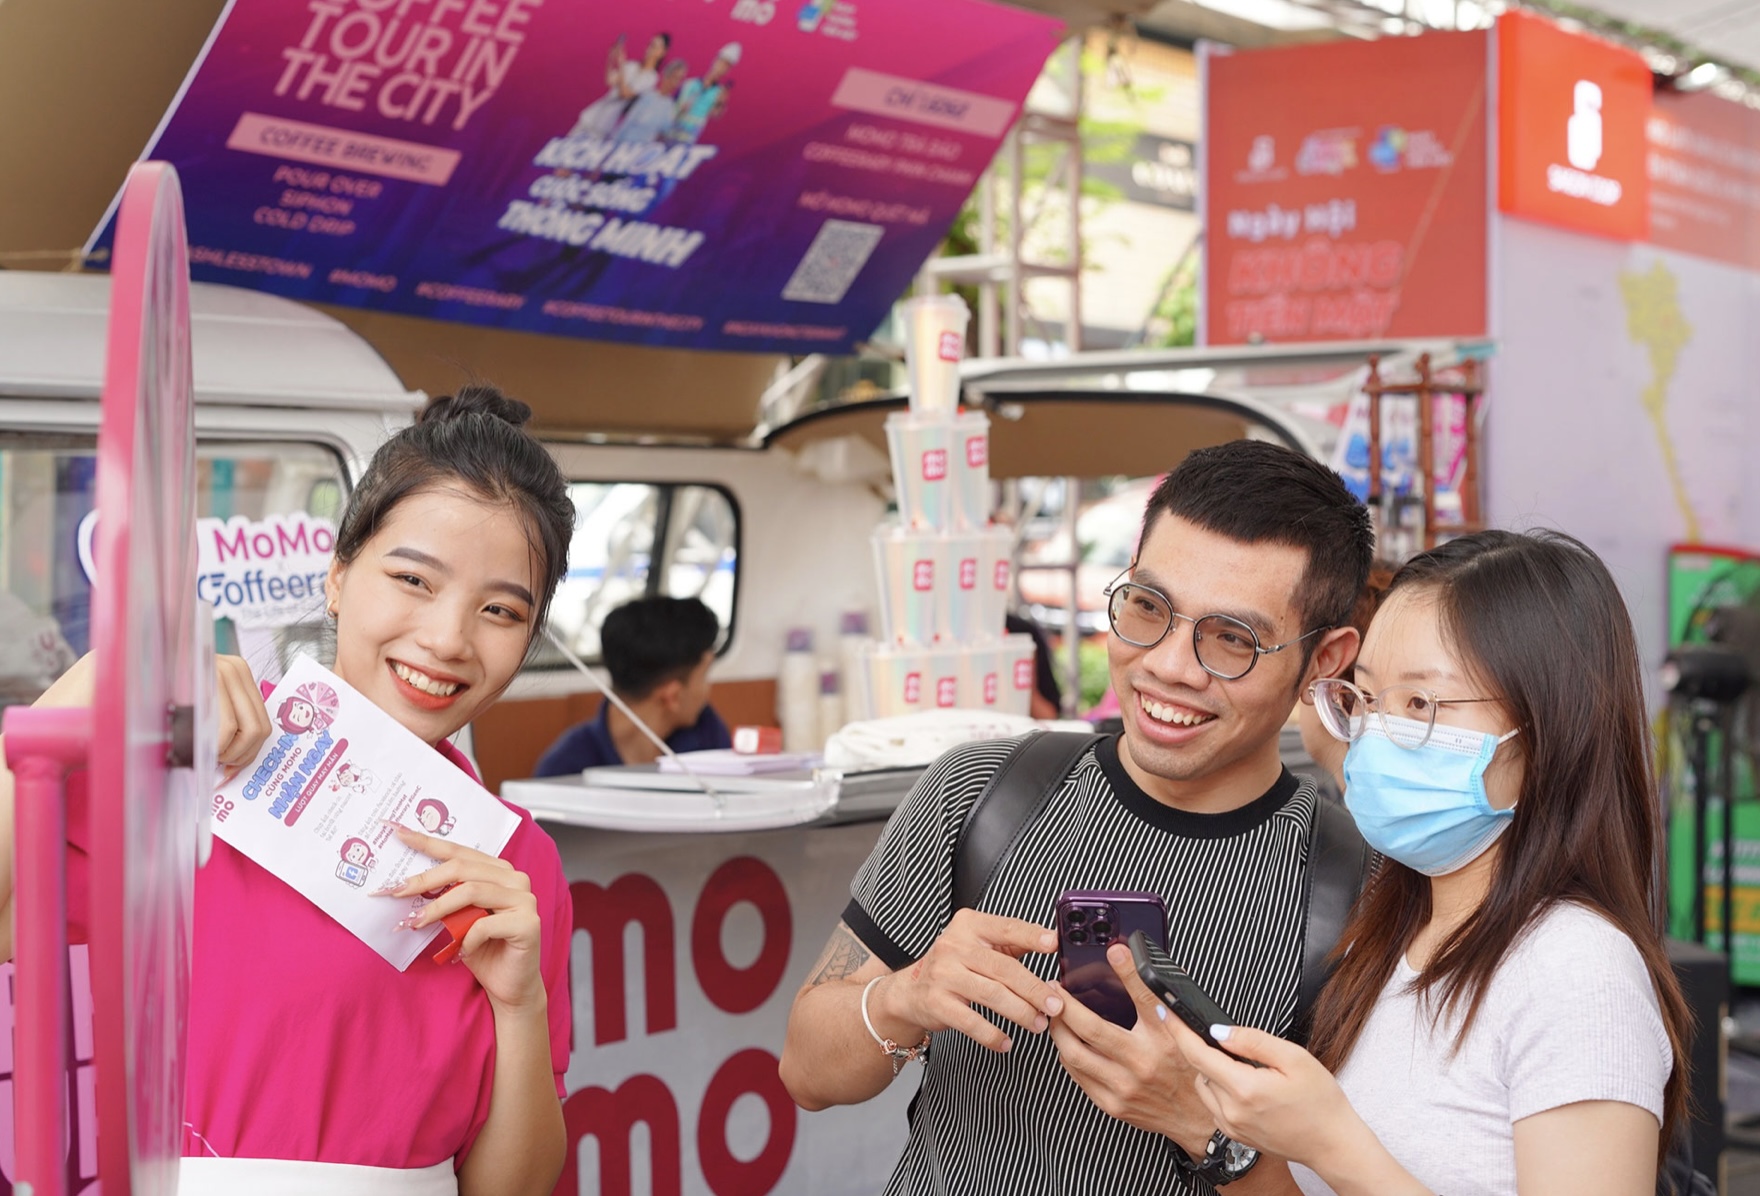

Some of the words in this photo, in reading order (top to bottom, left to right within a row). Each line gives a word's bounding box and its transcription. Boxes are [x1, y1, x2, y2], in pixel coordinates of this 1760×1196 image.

[299, 1, 453, 76] TOUR
[451, 36, 519, 89] IN
[274, 47, 382, 111] THE
[377, 71, 495, 131] CITY
[259, 125, 339, 154] COFFEE
[342, 141, 434, 172] BREWING
[272, 165, 331, 191] POUR
[329, 174, 383, 199] OVER
[252, 205, 309, 231] COLD
[307, 213, 357, 236] DRIP
[588, 216, 706, 269] MINH
[213, 521, 335, 564] MoMo
[242, 732, 298, 801] CHECK-IN
[265, 773, 285, 797] CÙNG
[282, 747, 302, 773] MOMO
[268, 771, 307, 819] NHẬN
[298, 730, 334, 776] NGAY
[307, 779, 320, 797] QUAY
[216, 800, 235, 823] mo
[569, 855, 793, 1054] mo
[551, 1046, 798, 1196] mo
